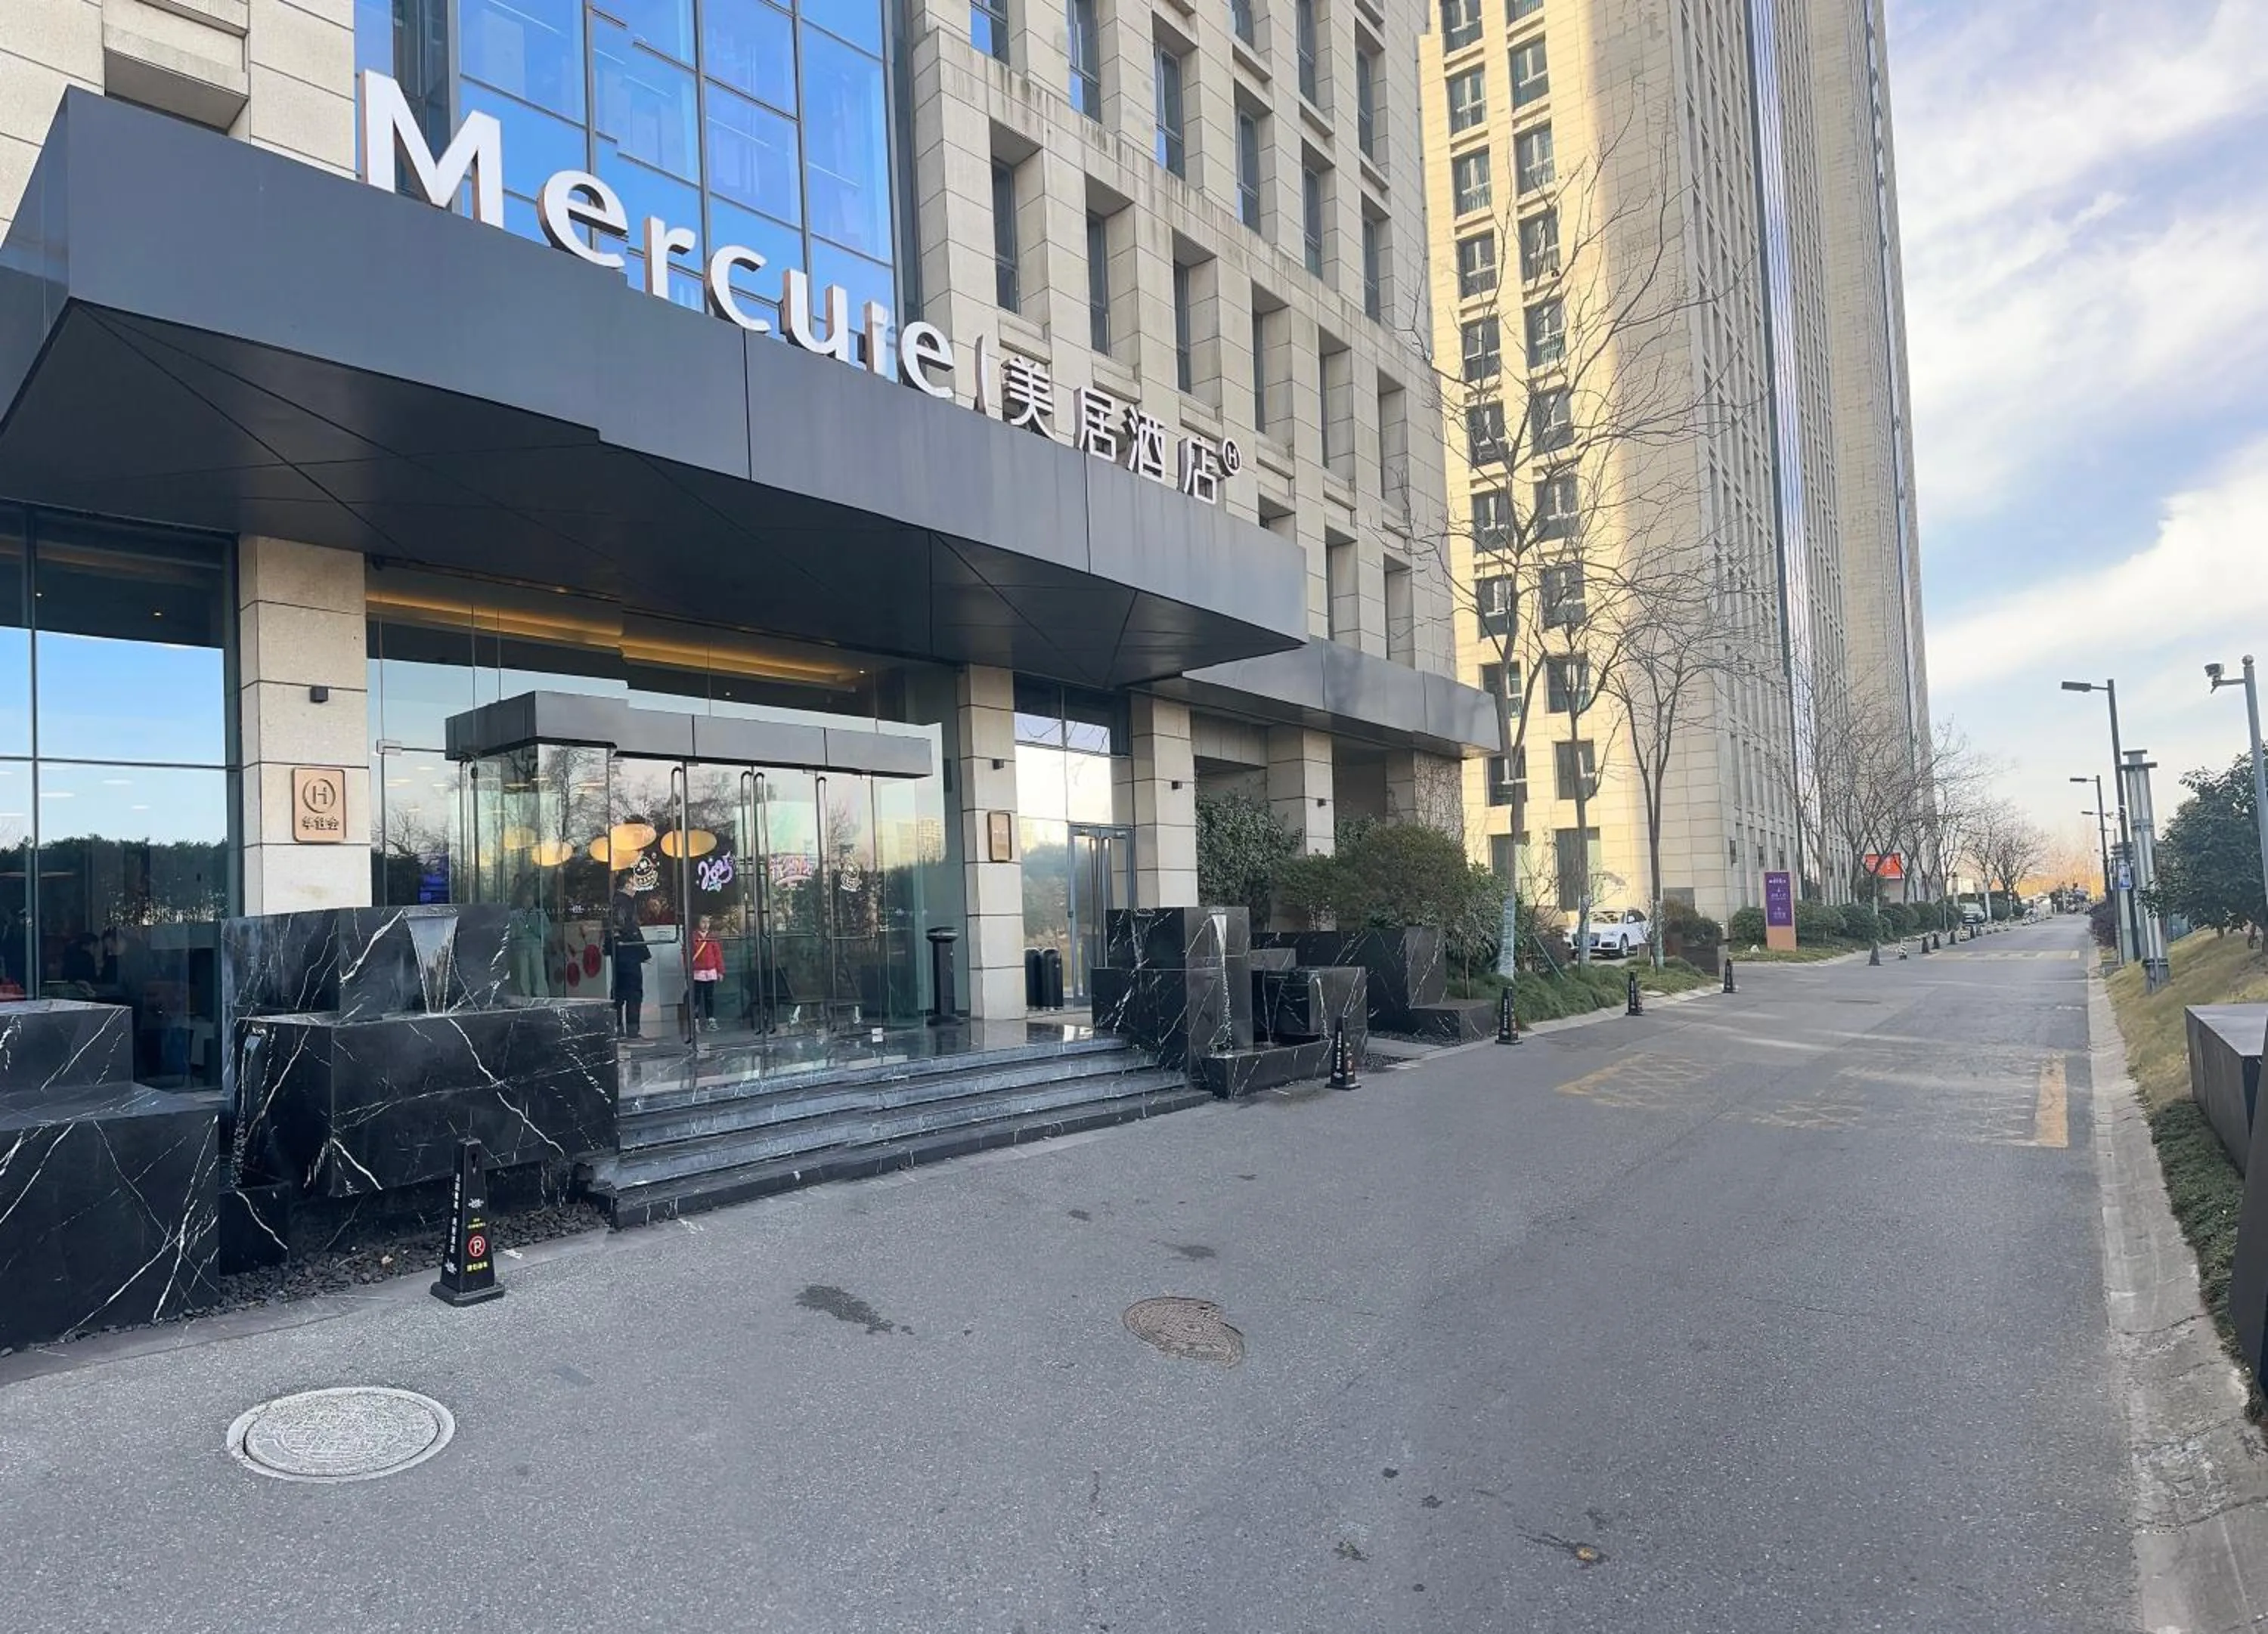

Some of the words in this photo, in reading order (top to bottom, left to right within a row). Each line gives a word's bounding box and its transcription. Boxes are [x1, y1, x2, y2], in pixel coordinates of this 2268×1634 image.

[360, 69, 954, 398] Mercure
[1002, 355, 1216, 504] 美居酒店
[1226, 443, 1239, 469] H
[312, 785, 327, 805] H
